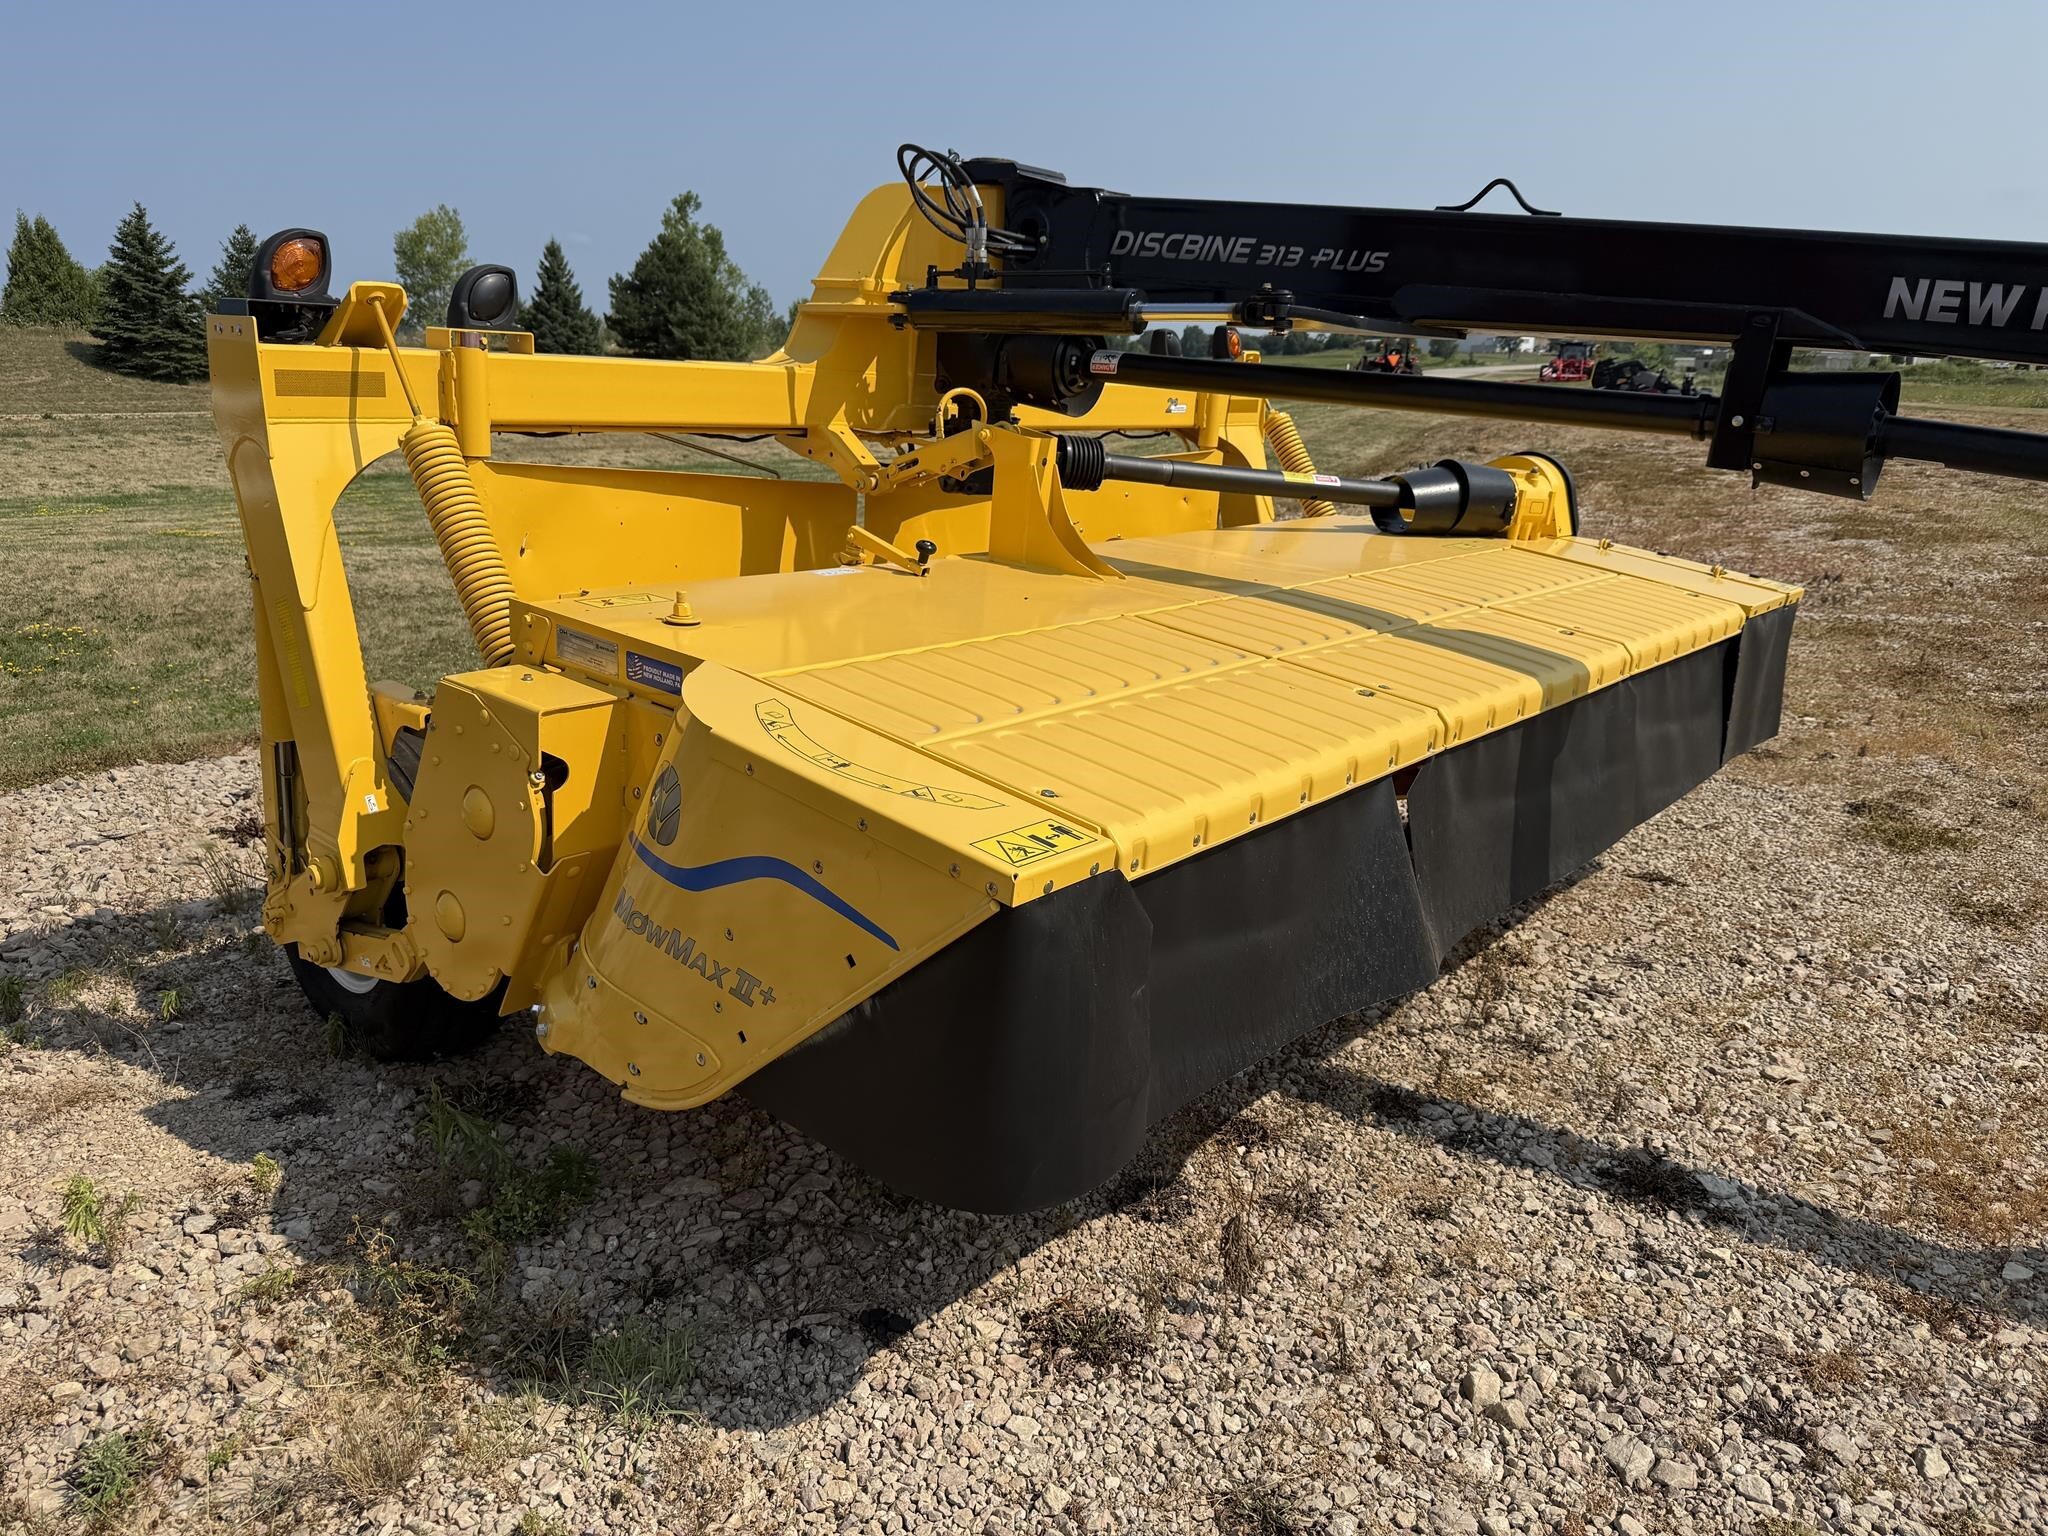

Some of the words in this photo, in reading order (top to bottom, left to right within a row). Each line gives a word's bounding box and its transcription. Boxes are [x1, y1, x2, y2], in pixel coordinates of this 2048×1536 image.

[1110, 230, 1257, 264] DISCBINE
[1255, 244, 1304, 267] 313
[1883, 276, 2026, 328] NEW
[643, 665, 662, 676] PROUDLY
[662, 670, 675, 680] MADE
[643, 671, 653, 679] NEW
